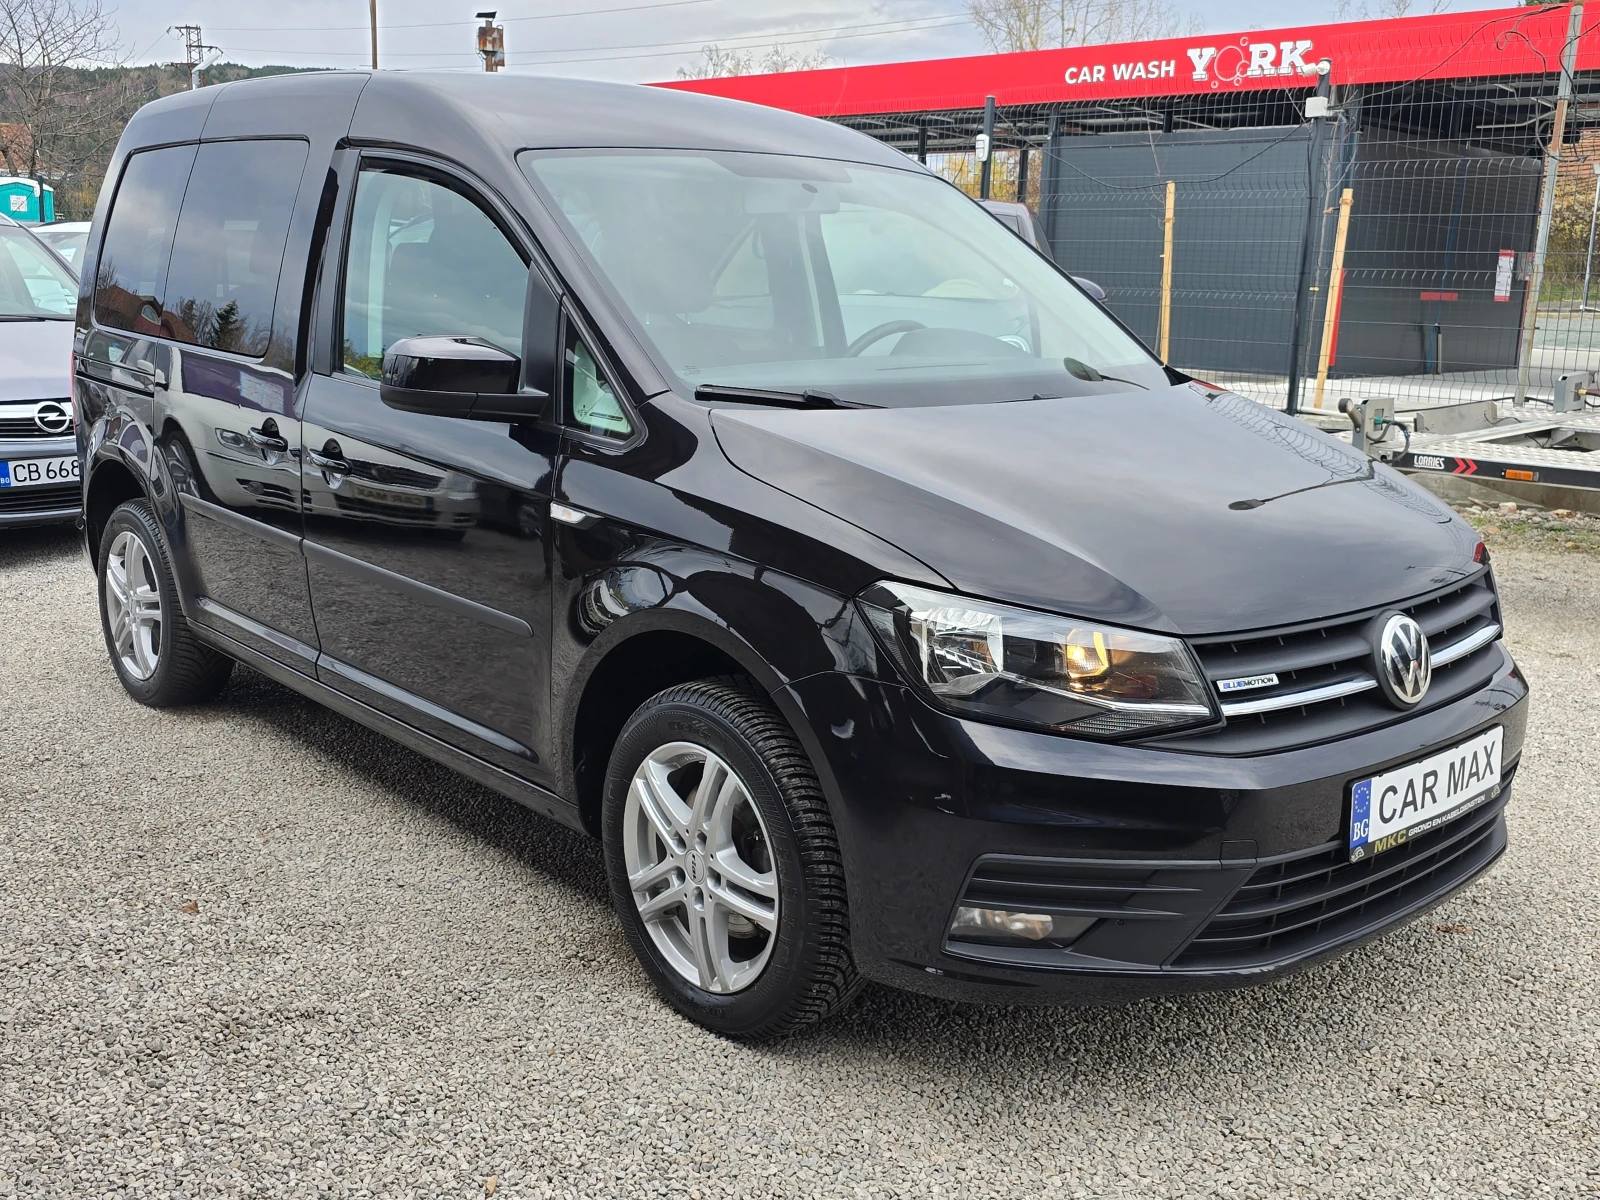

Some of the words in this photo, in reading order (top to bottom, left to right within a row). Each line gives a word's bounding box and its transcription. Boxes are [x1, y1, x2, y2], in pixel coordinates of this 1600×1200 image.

[1064, 65, 1106, 85] CAR
[1112, 60, 1176, 81] WASH
[1187, 40, 1313, 82] YORK
[13, 463, 41, 482] CB
[1414, 455, 1445, 469] LORRIES
[1222, 676, 1274, 689] BLUEMOTION
[1378, 769, 1439, 825] CAR
[1446, 740, 1496, 799] MAX
[1352, 818, 1369, 842] BG
[1374, 829, 1407, 854] MKC
[1408, 820, 1432, 837] GROND
[1432, 817, 1442, 827] EN
[1441, 793, 1486, 823] KABELDIENSTEN
